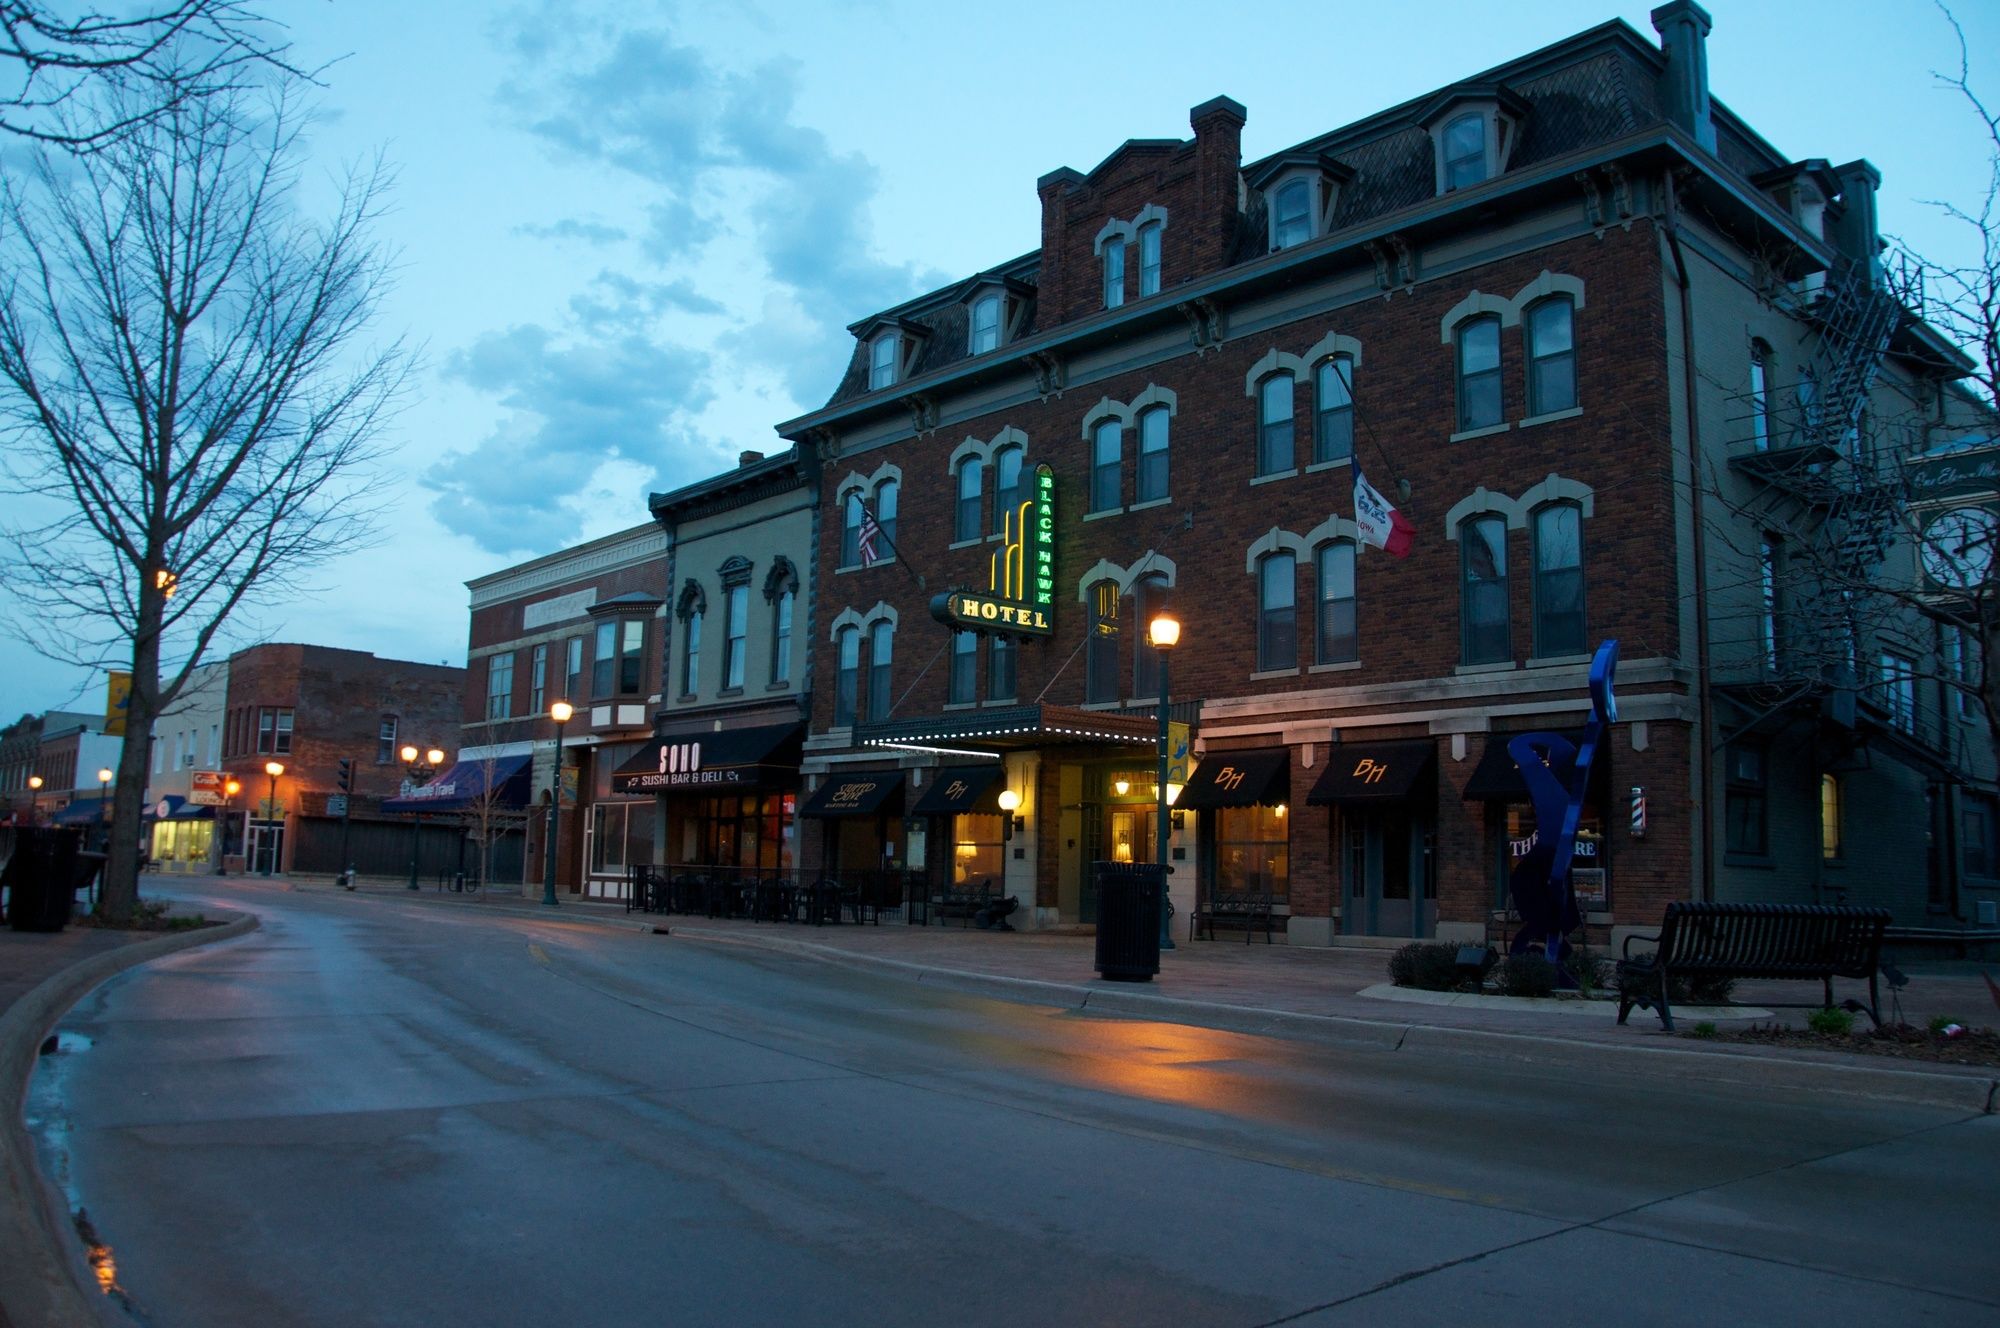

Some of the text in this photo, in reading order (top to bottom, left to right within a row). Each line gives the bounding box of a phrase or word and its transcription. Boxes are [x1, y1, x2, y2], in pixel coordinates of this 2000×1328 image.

[1357, 519, 1375, 535] IOWA
[1037, 476, 1053, 604] BLACK HAWK
[962, 599, 1048, 629] HOTEL
[659, 742, 701, 774] SOHO
[641, 771, 722, 786] SUSHI BAR & DELI
[435, 781, 456, 796] Travel
[840, 782, 877, 794] STUFFED
